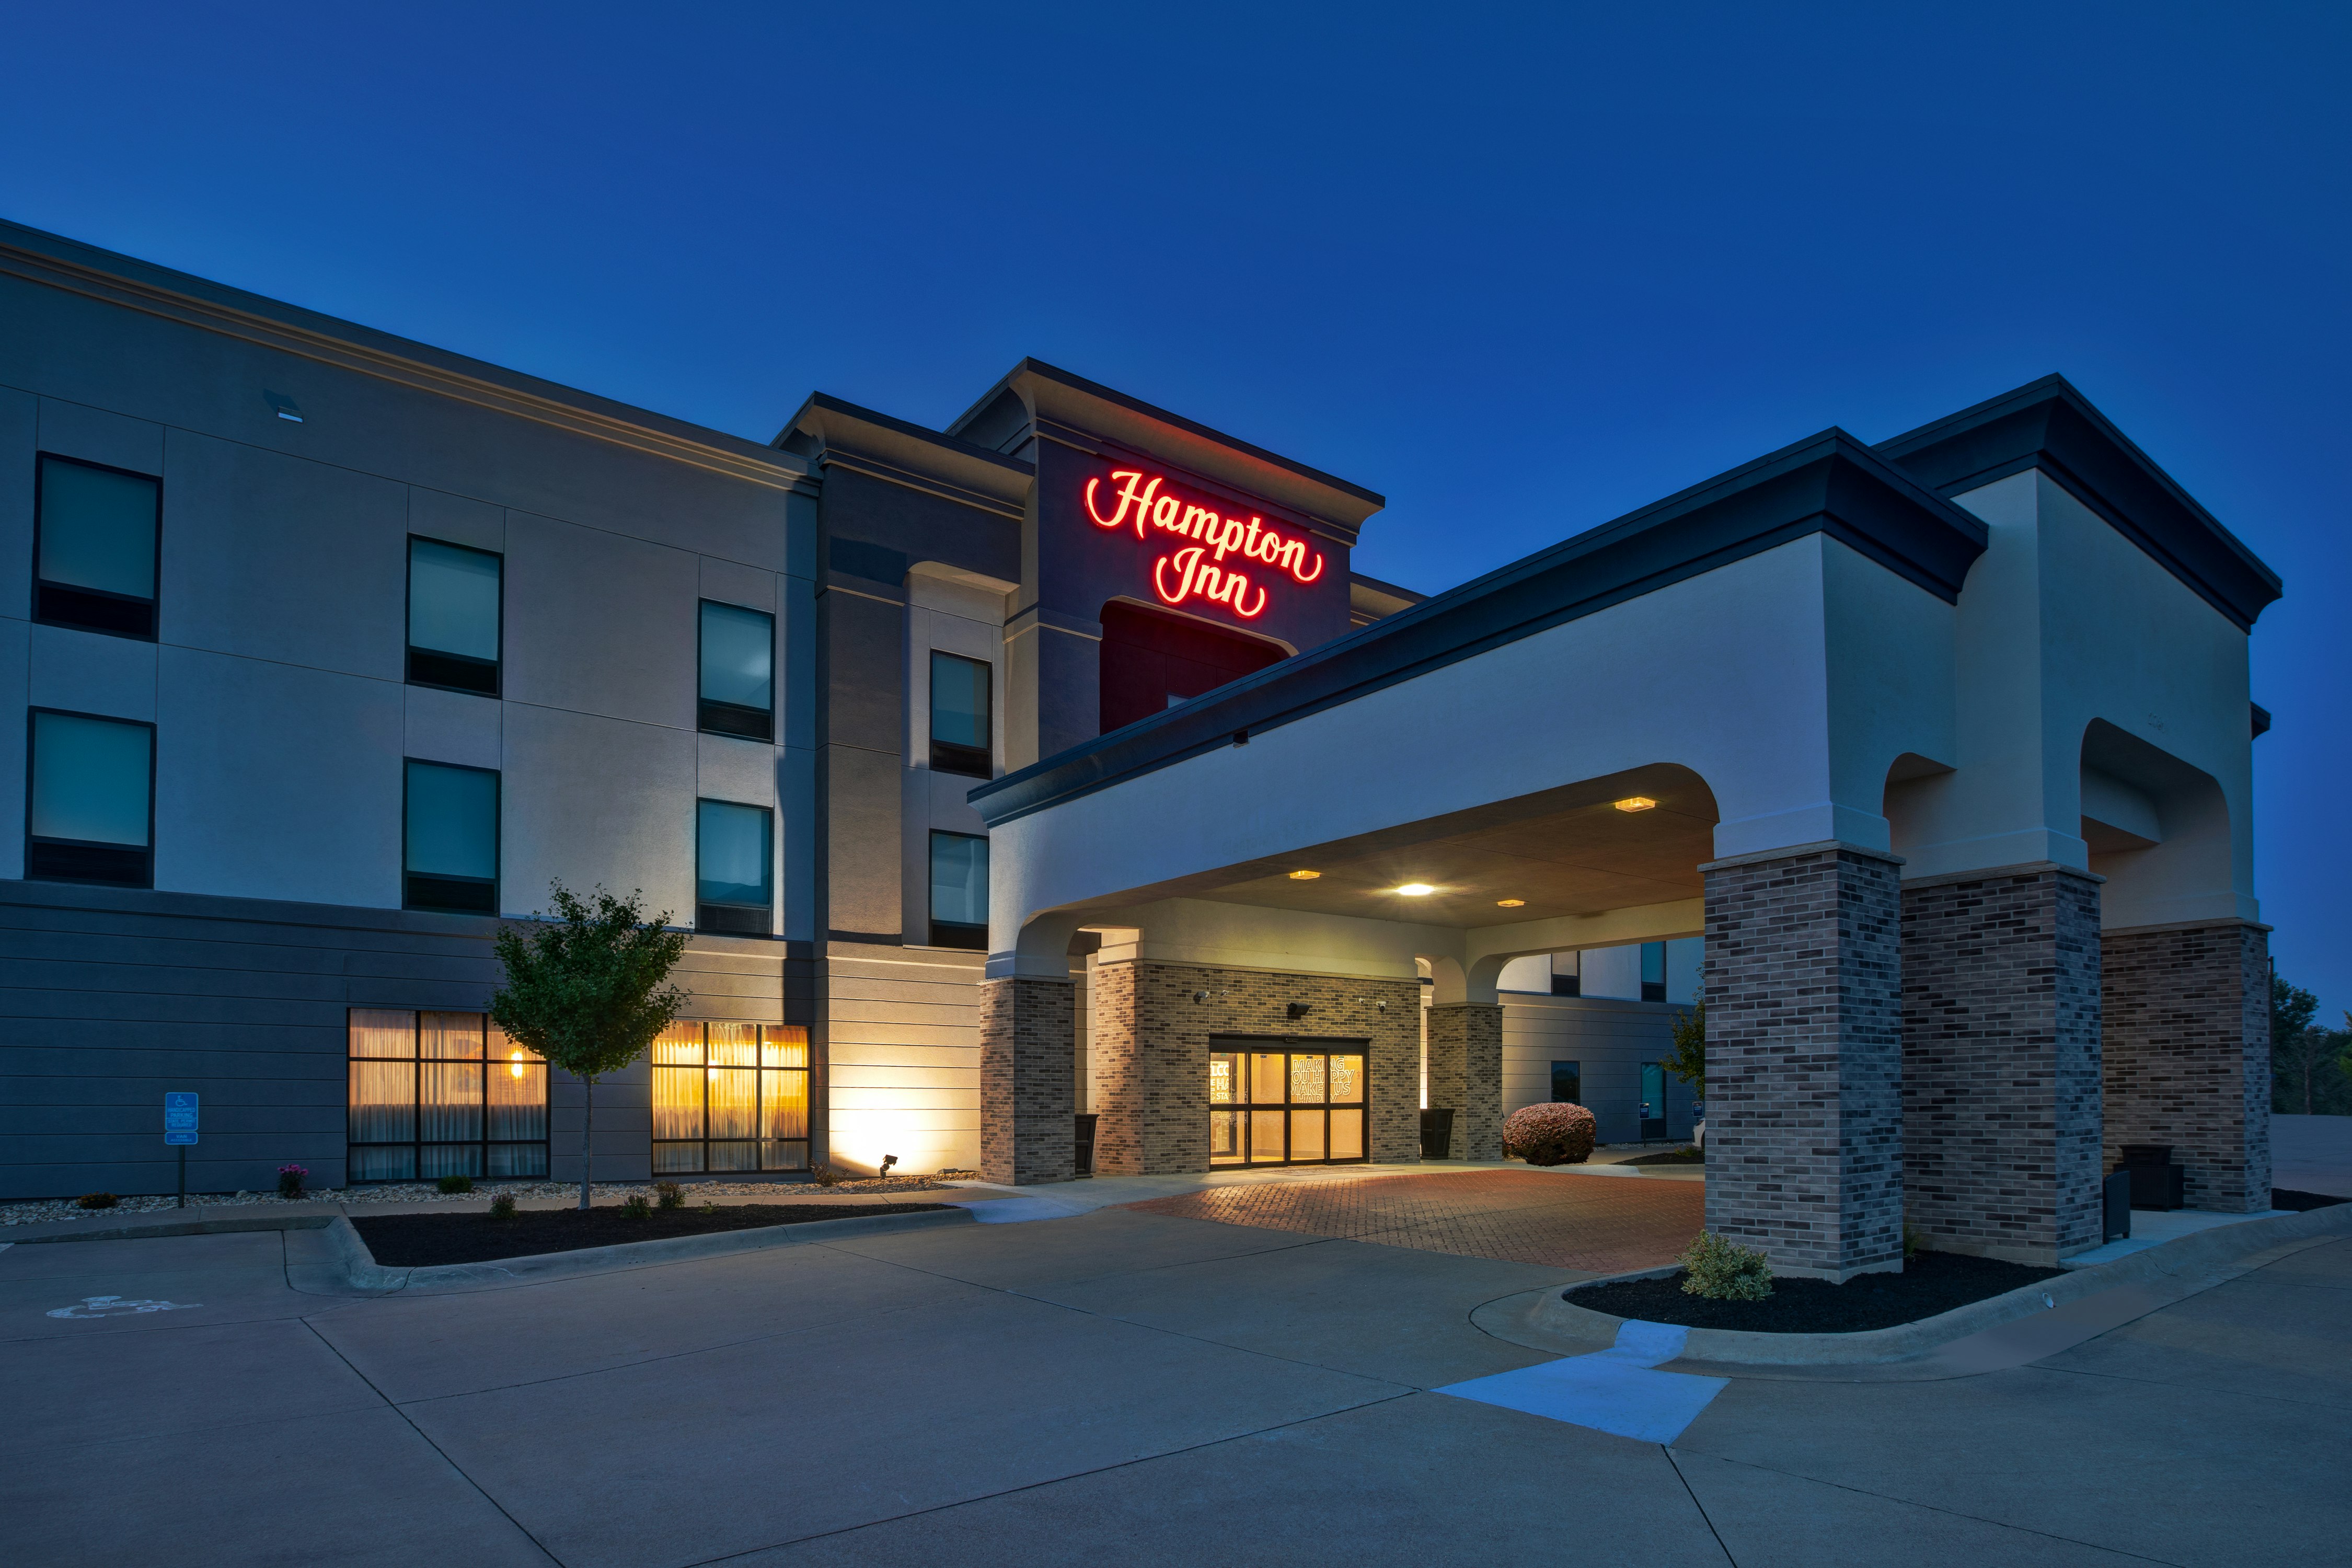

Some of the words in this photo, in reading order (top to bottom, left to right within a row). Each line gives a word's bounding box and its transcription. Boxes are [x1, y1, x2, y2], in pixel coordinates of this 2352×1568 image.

[1087, 471, 1322, 581] Hampton
[1156, 547, 1265, 616] Inn
[1291, 1071, 1309, 1083] OU
[1334, 1081, 1351, 1095] US
